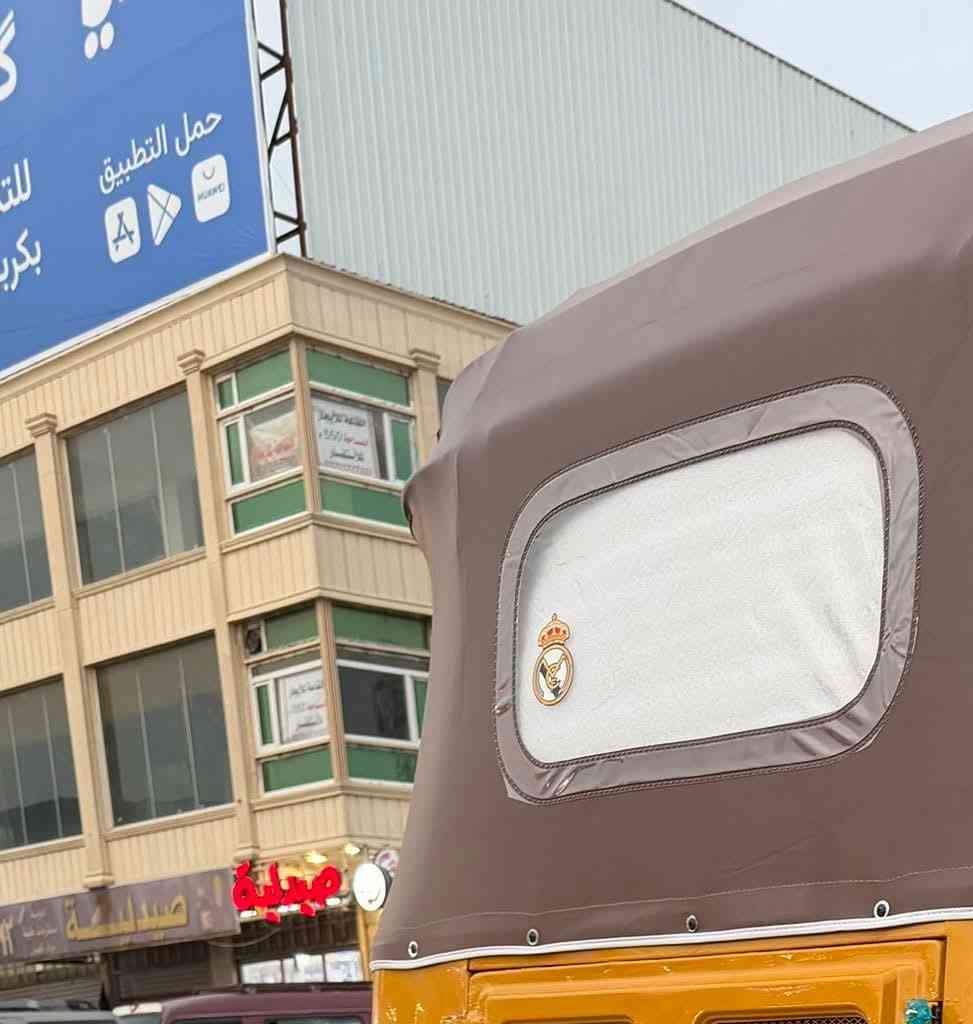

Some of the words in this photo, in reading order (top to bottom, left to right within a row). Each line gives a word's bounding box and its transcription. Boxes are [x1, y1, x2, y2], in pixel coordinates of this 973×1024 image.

[99, 123, 169, 195] التطبيق
[175, 111, 223, 157] حمل
[232, 858, 342, 925] صيدلية
